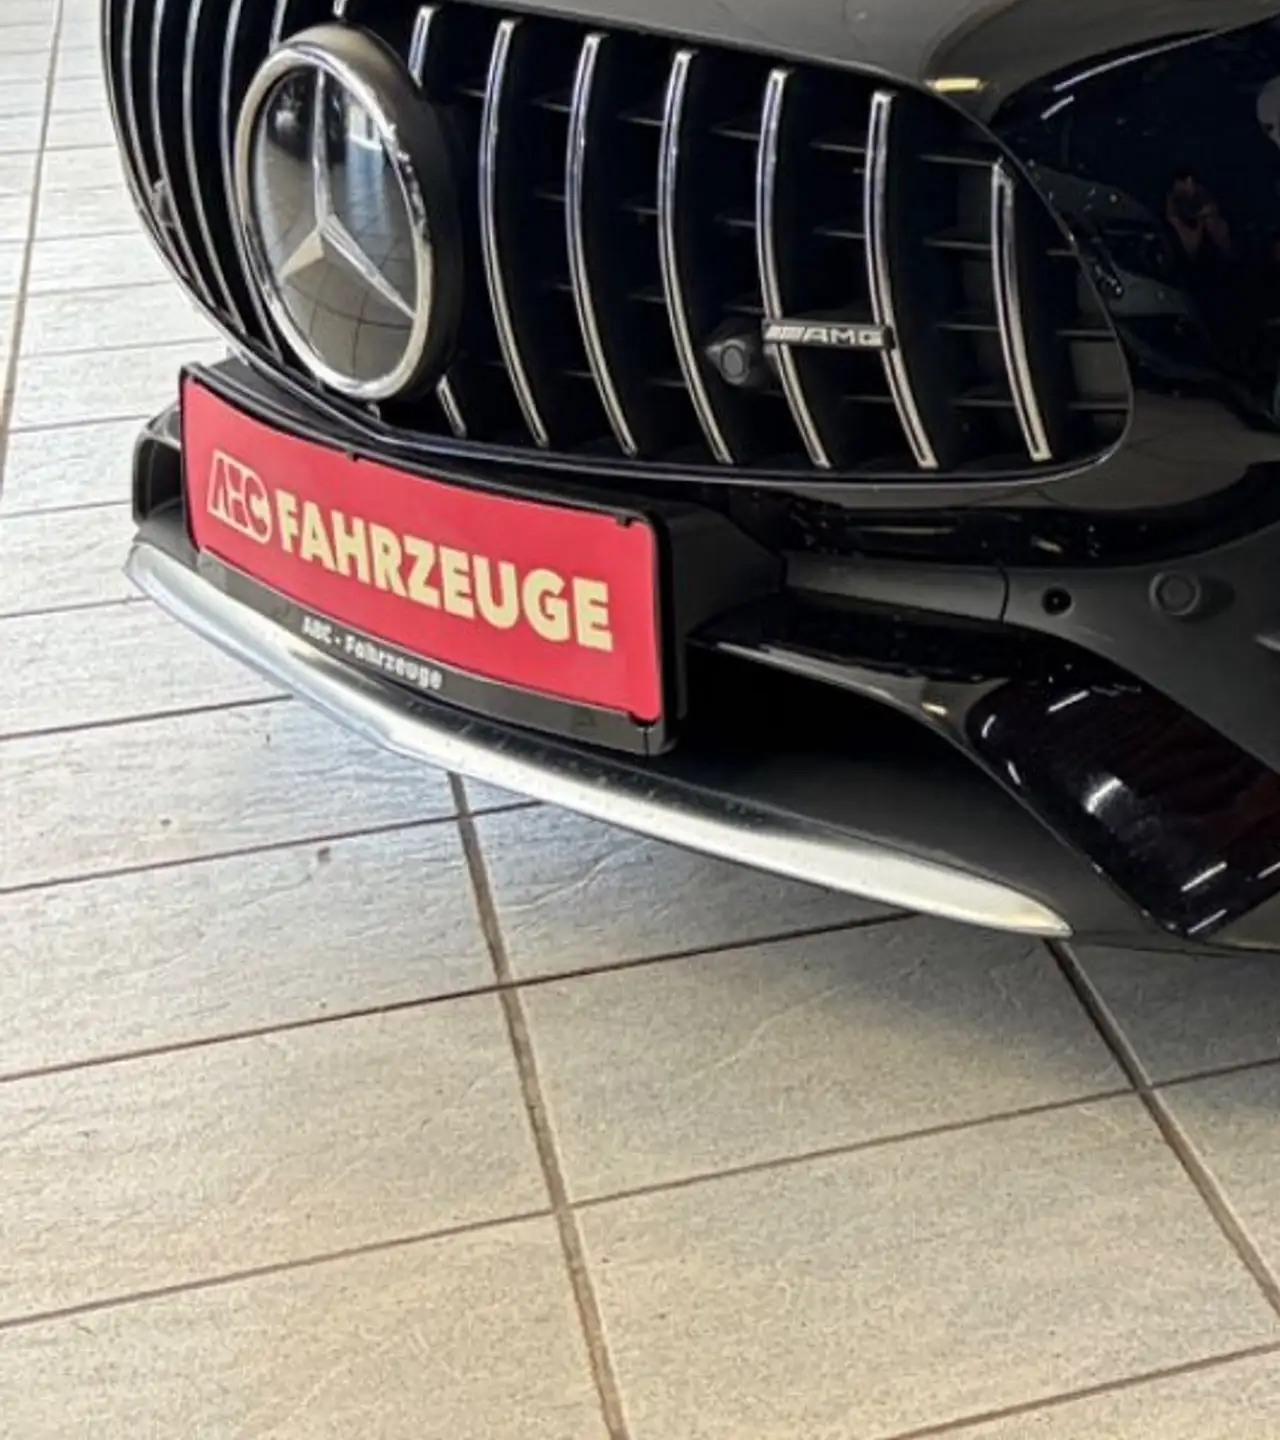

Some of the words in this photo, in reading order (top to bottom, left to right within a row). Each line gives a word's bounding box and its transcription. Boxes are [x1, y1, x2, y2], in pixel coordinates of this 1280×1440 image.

[801, 325, 884, 347] AMG
[275, 489, 614, 652] FAHRZEUGE
[344, 633, 443, 690] Fahrzeuge
